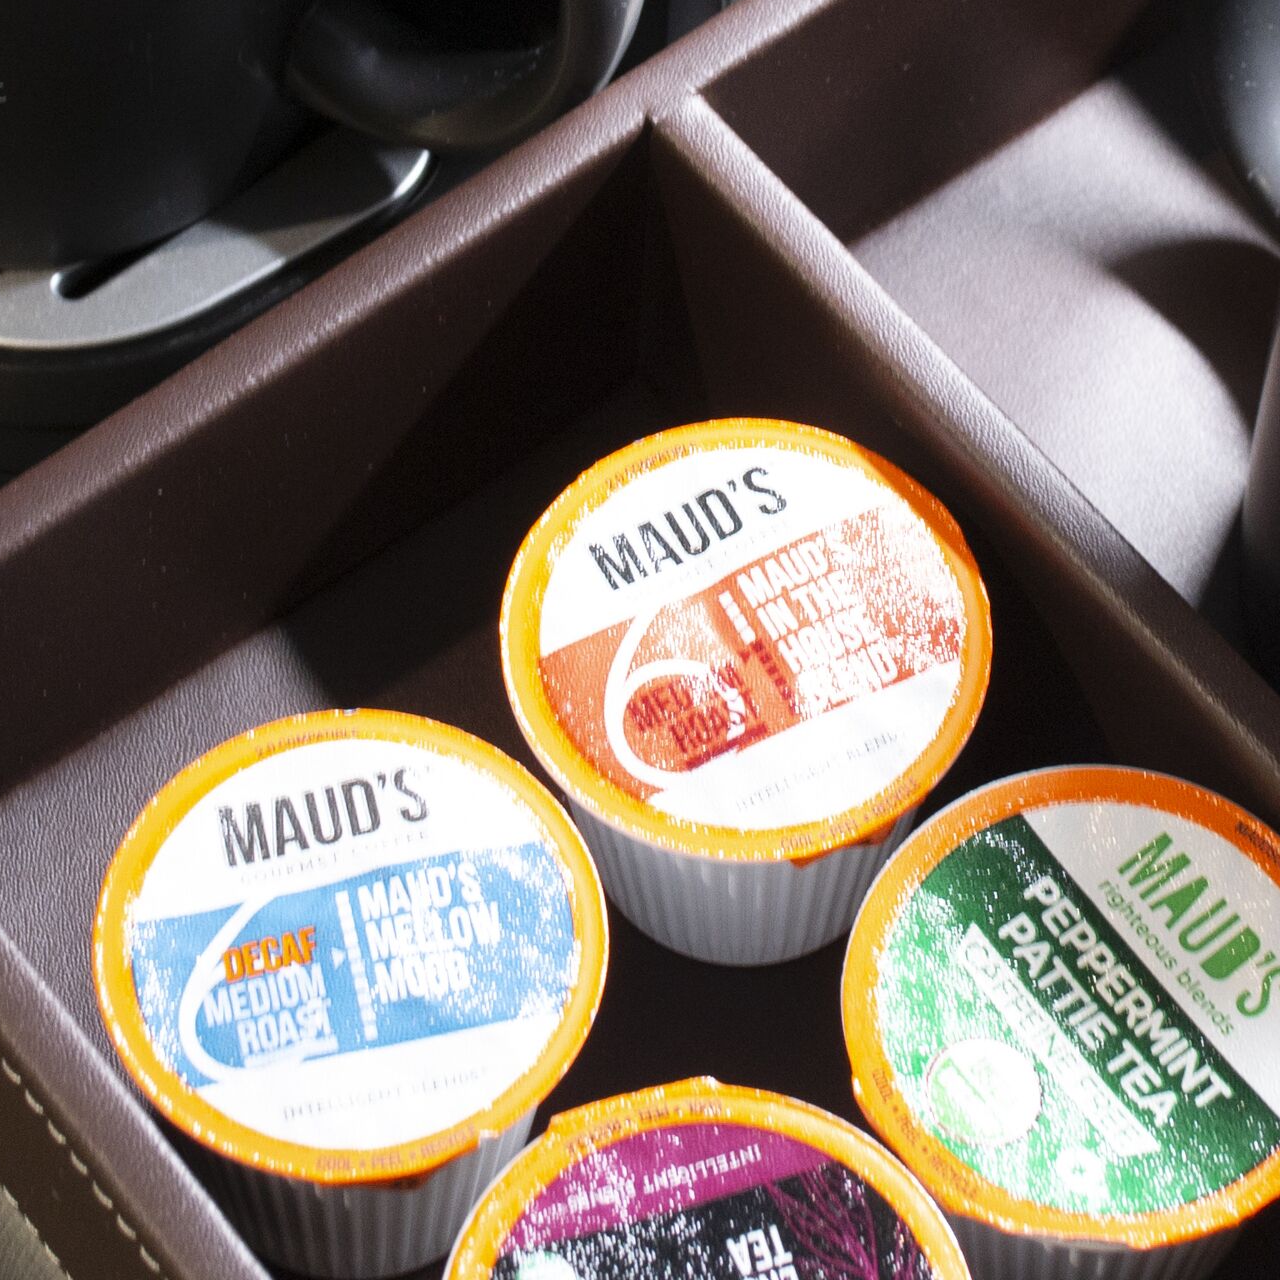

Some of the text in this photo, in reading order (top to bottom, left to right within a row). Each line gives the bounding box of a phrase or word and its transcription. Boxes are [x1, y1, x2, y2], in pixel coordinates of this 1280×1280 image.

[588, 465, 788, 591] MAUD'S
[735, 530, 856, 609] MAUD'S
[754, 568, 859, 641] IN THE
[776, 602, 882, 673] HOUSE
[218, 765, 430, 869] MAUD'S
[358, 862, 484, 921] MAUD'S
[222, 926, 318, 984] DECAF
[365, 901, 503, 960] MELLOW
[1096, 879, 1234, 1037] righteous blends
[204, 964, 327, 1028] MEDIUM
[375, 954, 471, 1005] MOOD
[1023, 874, 1234, 1108] PEPPERMINT
[237, 997, 332, 1058] ROAST
[997, 911, 1180, 1129] PATTIE TEA
[643, 1141, 763, 1193] INTELLIGENT
[725, 1222, 795, 1273] TEA
